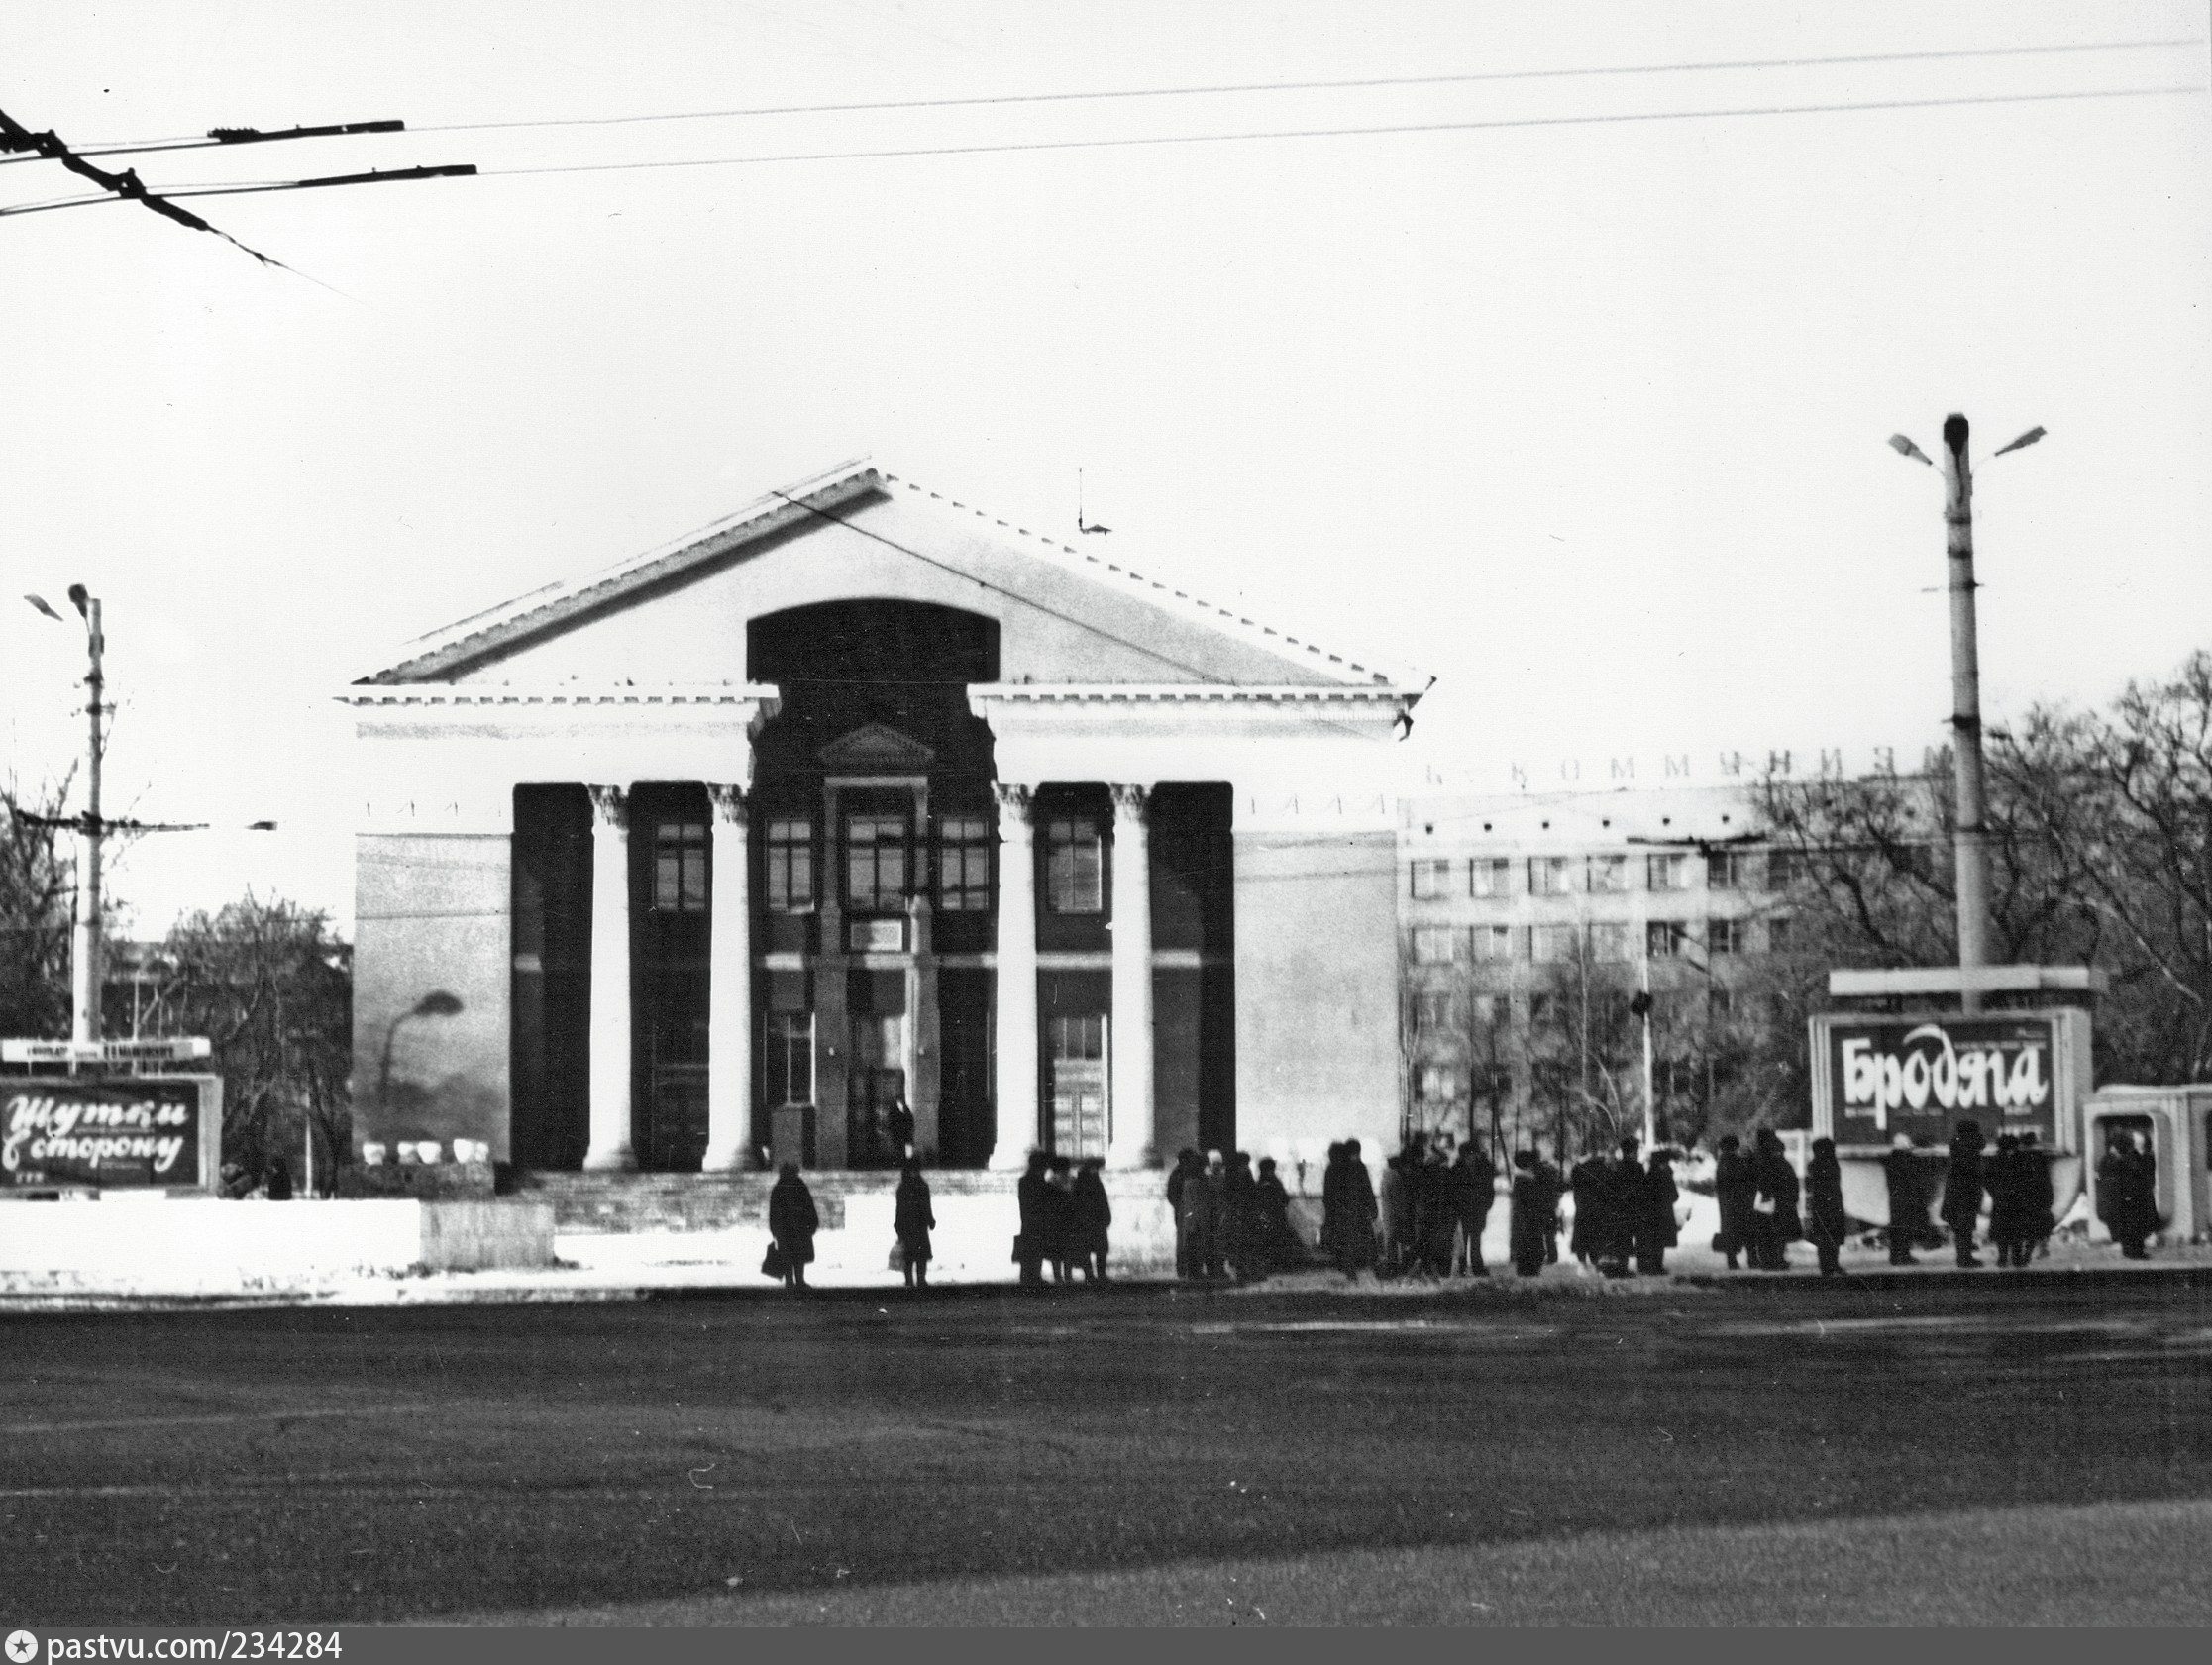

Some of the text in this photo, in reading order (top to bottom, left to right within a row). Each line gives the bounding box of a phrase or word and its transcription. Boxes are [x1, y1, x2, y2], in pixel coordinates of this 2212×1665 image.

[1842, 1024, 2049, 1130] Бродяга
[6, 1095, 189, 1137] Шутки
[31, 1136, 184, 1172] сторону
